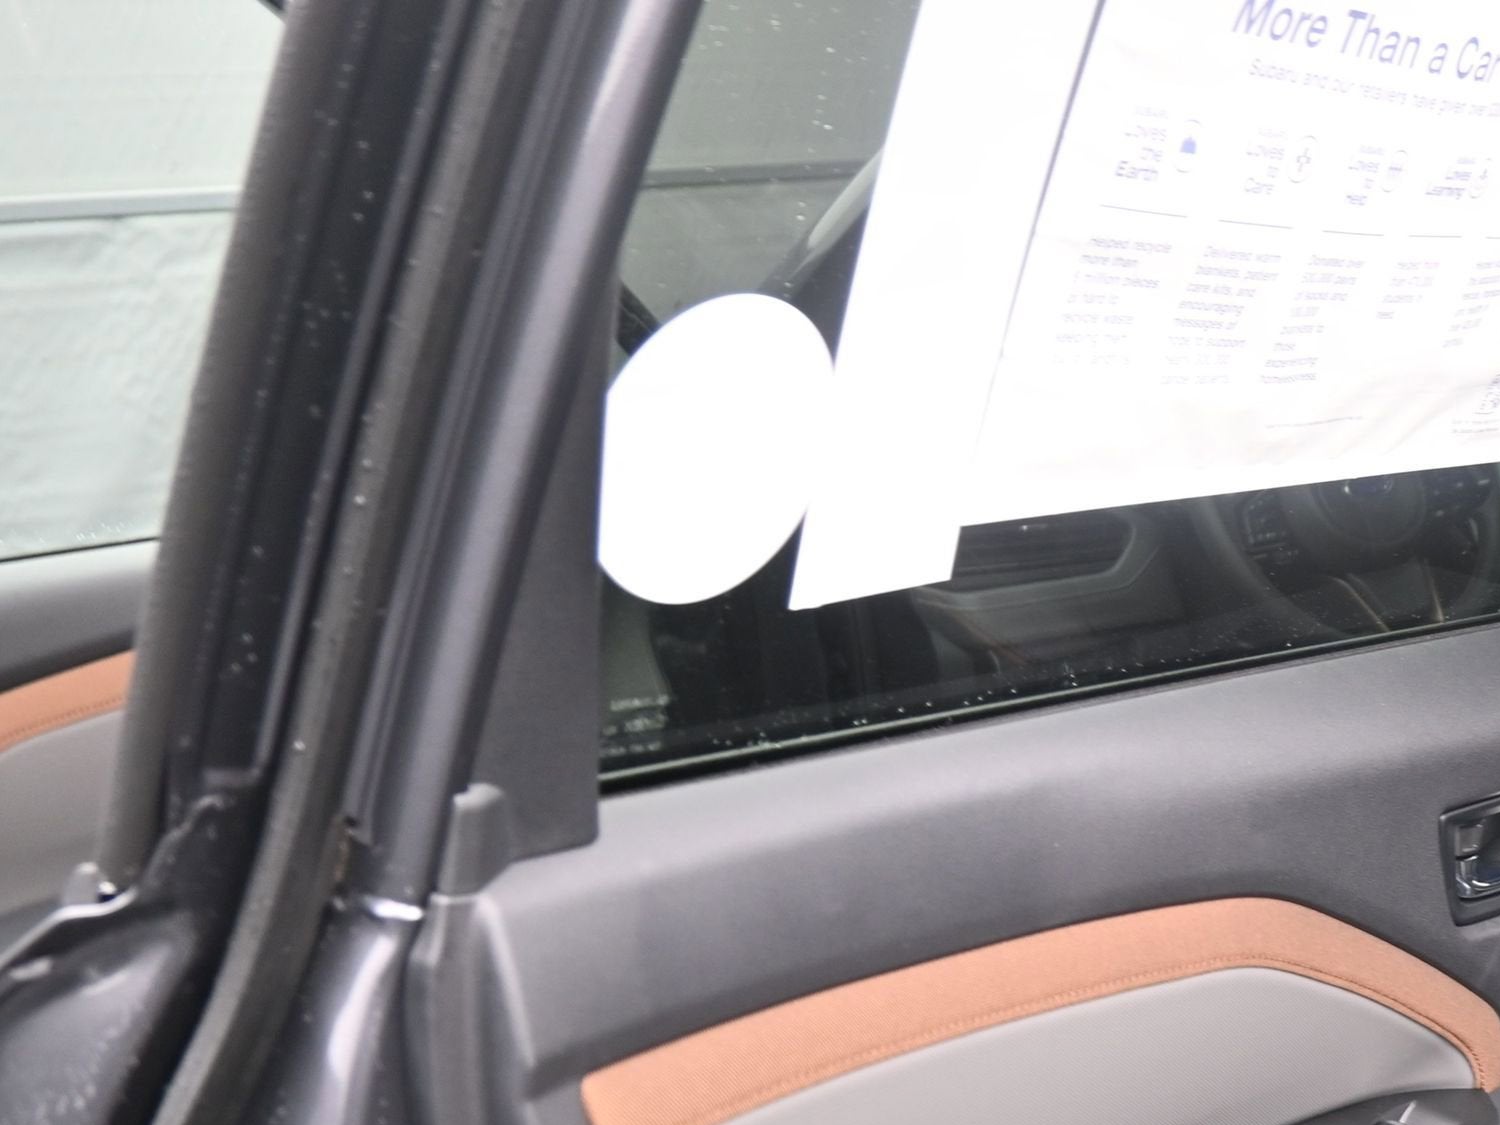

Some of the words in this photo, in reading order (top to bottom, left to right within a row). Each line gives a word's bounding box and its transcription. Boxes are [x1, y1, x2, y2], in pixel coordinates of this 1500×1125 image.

[1231, 0, 1329, 49] More
[1339, 9, 1421, 69] Than
[1427, 42, 1449, 75] a
[1249, 57, 1297, 84] Subaru
[1303, 72, 1329, 93] and
[1114, 159, 1160, 182] Earth
[1243, 176, 1276, 196] Care
